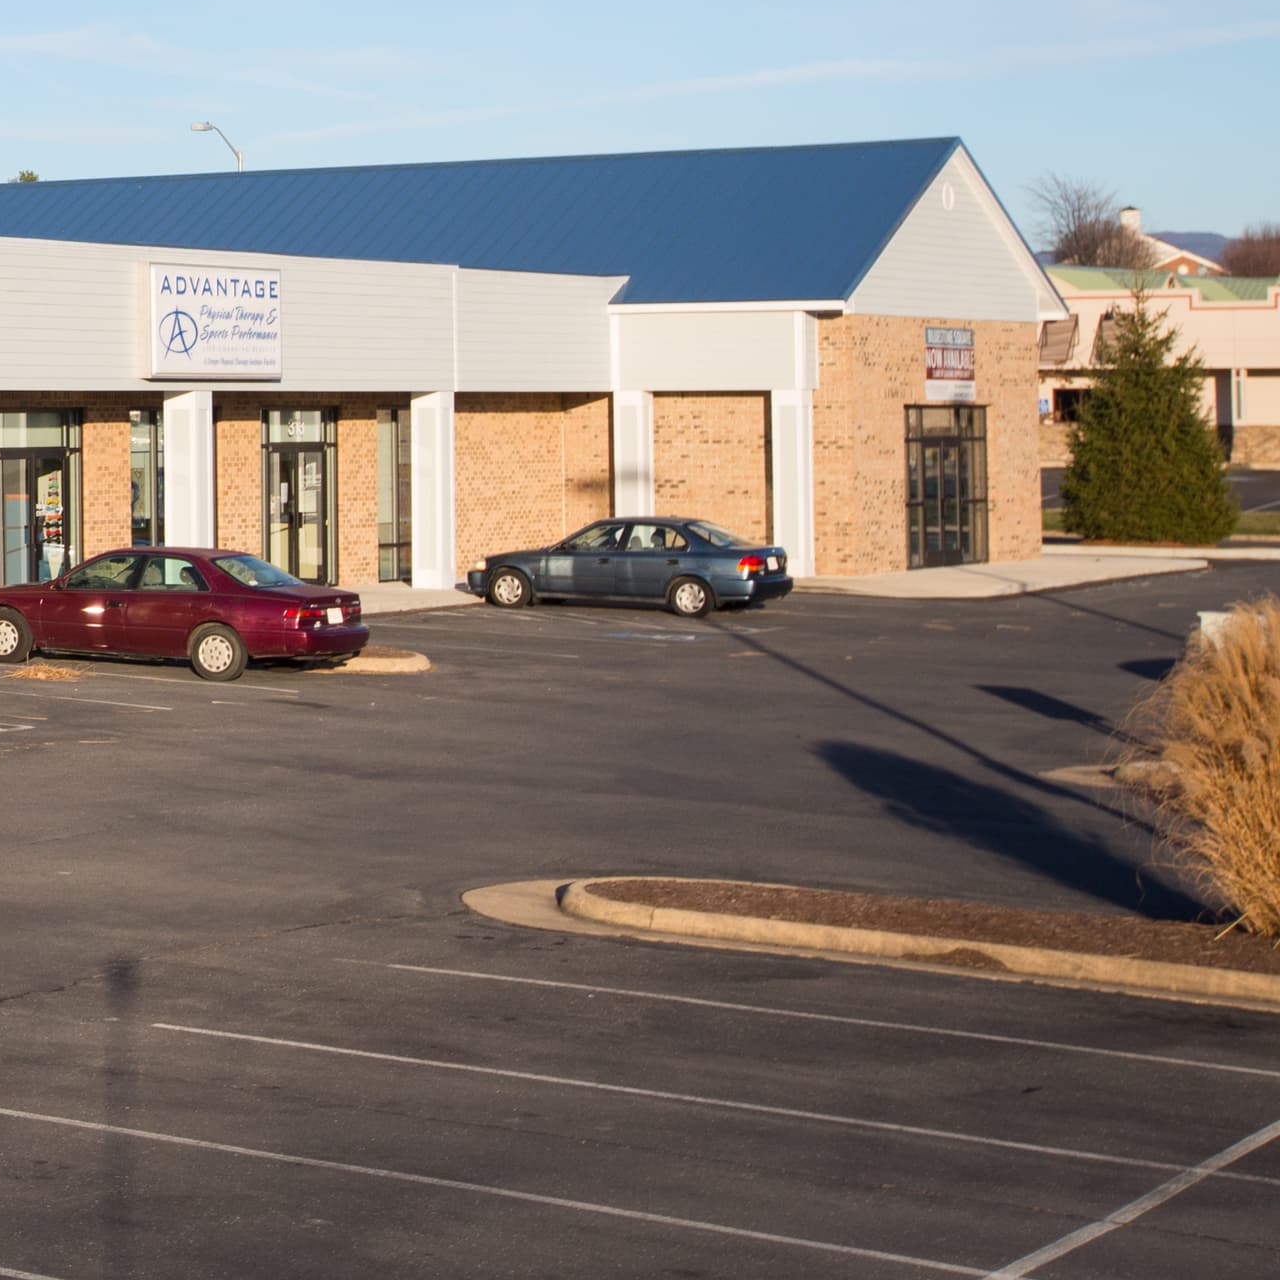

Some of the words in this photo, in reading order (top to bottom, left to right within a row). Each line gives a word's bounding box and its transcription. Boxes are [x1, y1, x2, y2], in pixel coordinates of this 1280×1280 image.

[160, 274, 278, 298] ADVANTAGE
[925, 348, 943, 368] NOW
[944, 349, 975, 369] AVAILABLE
